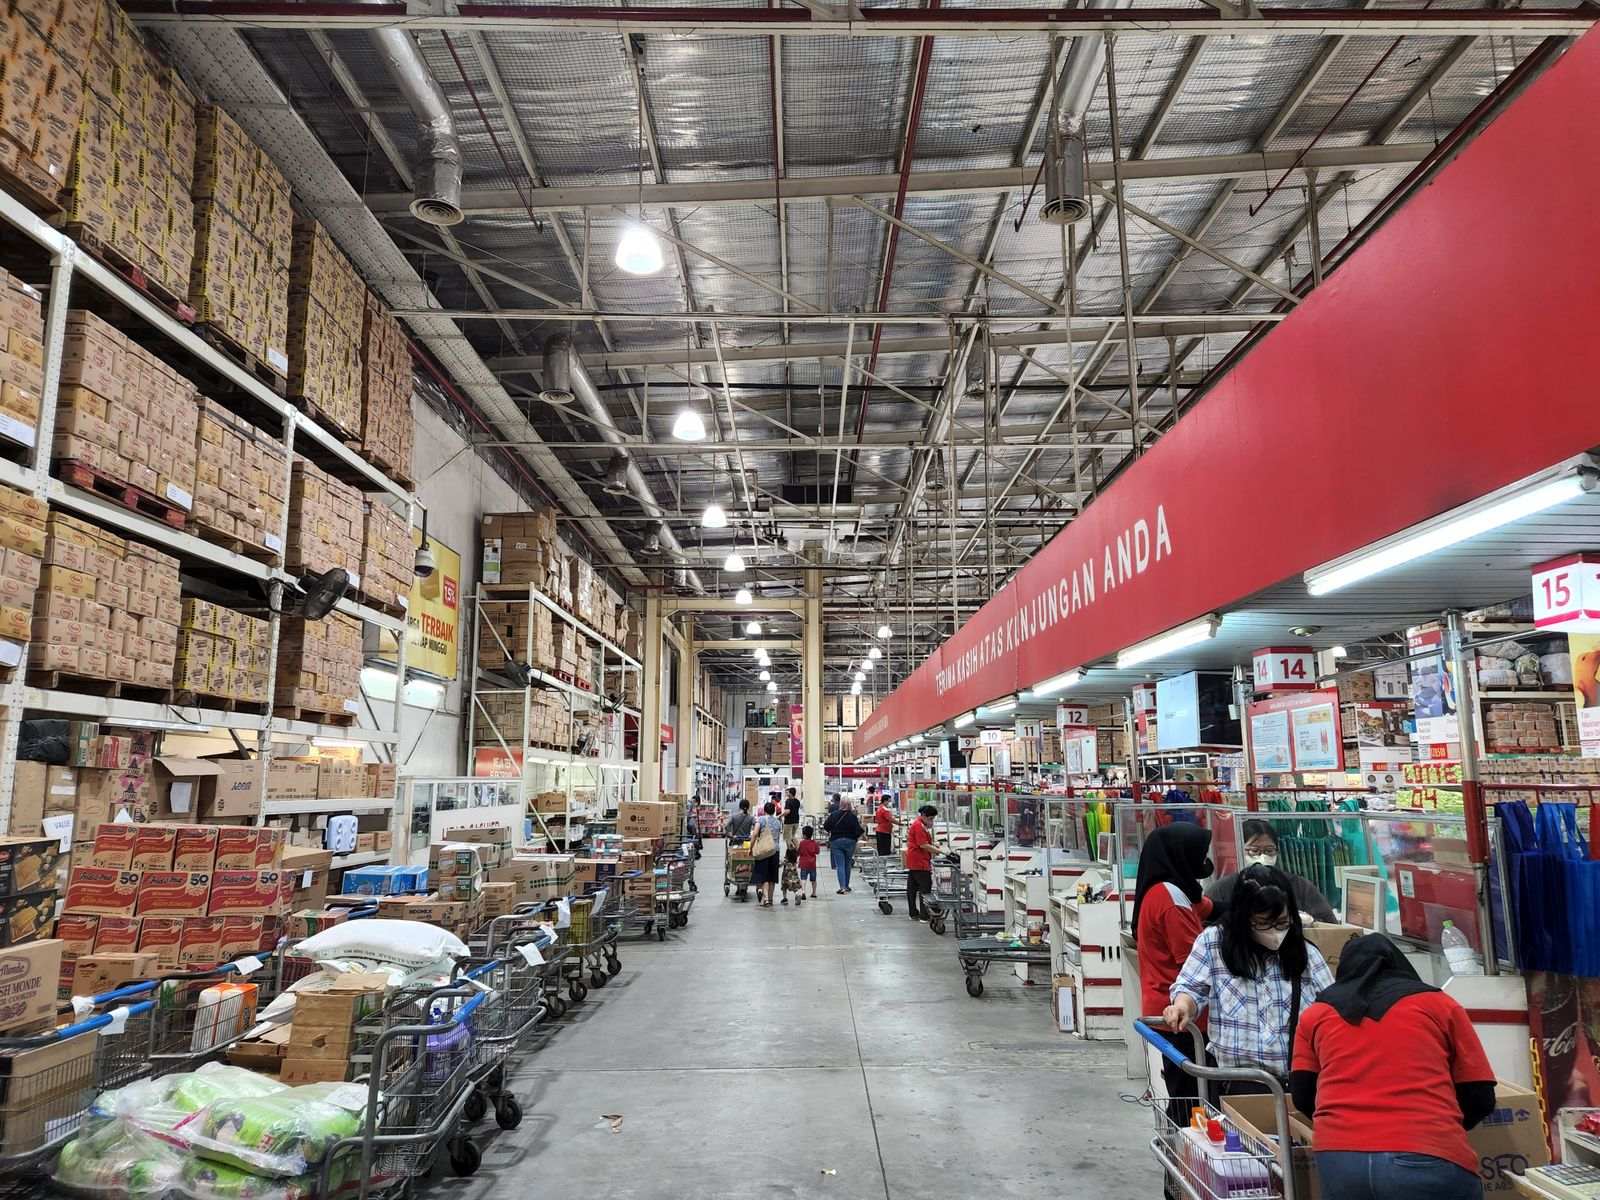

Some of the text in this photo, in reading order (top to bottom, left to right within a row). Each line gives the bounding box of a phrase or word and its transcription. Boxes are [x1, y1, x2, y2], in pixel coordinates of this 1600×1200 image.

[957, 644, 978, 685] KASIH
[979, 625, 1004, 669] ATAS
[1103, 503, 1172, 593] ANDA
[1541, 572, 1570, 610] 15
[421, 612, 454, 643] TERBAIK
[1257, 659, 1268, 680] 14
[1280, 658, 1307, 679] 14
[1068, 711, 1082, 724] 12
[987, 732, 998, 740] 10
[1024, 726, 1034, 737] 11
[965, 738, 971, 747] 9
[1403, 762, 1462, 784] LOTTE
[120, 873, 139, 885] 50
[190, 874, 209, 886] 50
[261, 872, 279, 884] 50
[12, 976, 42, 994] MONDE
